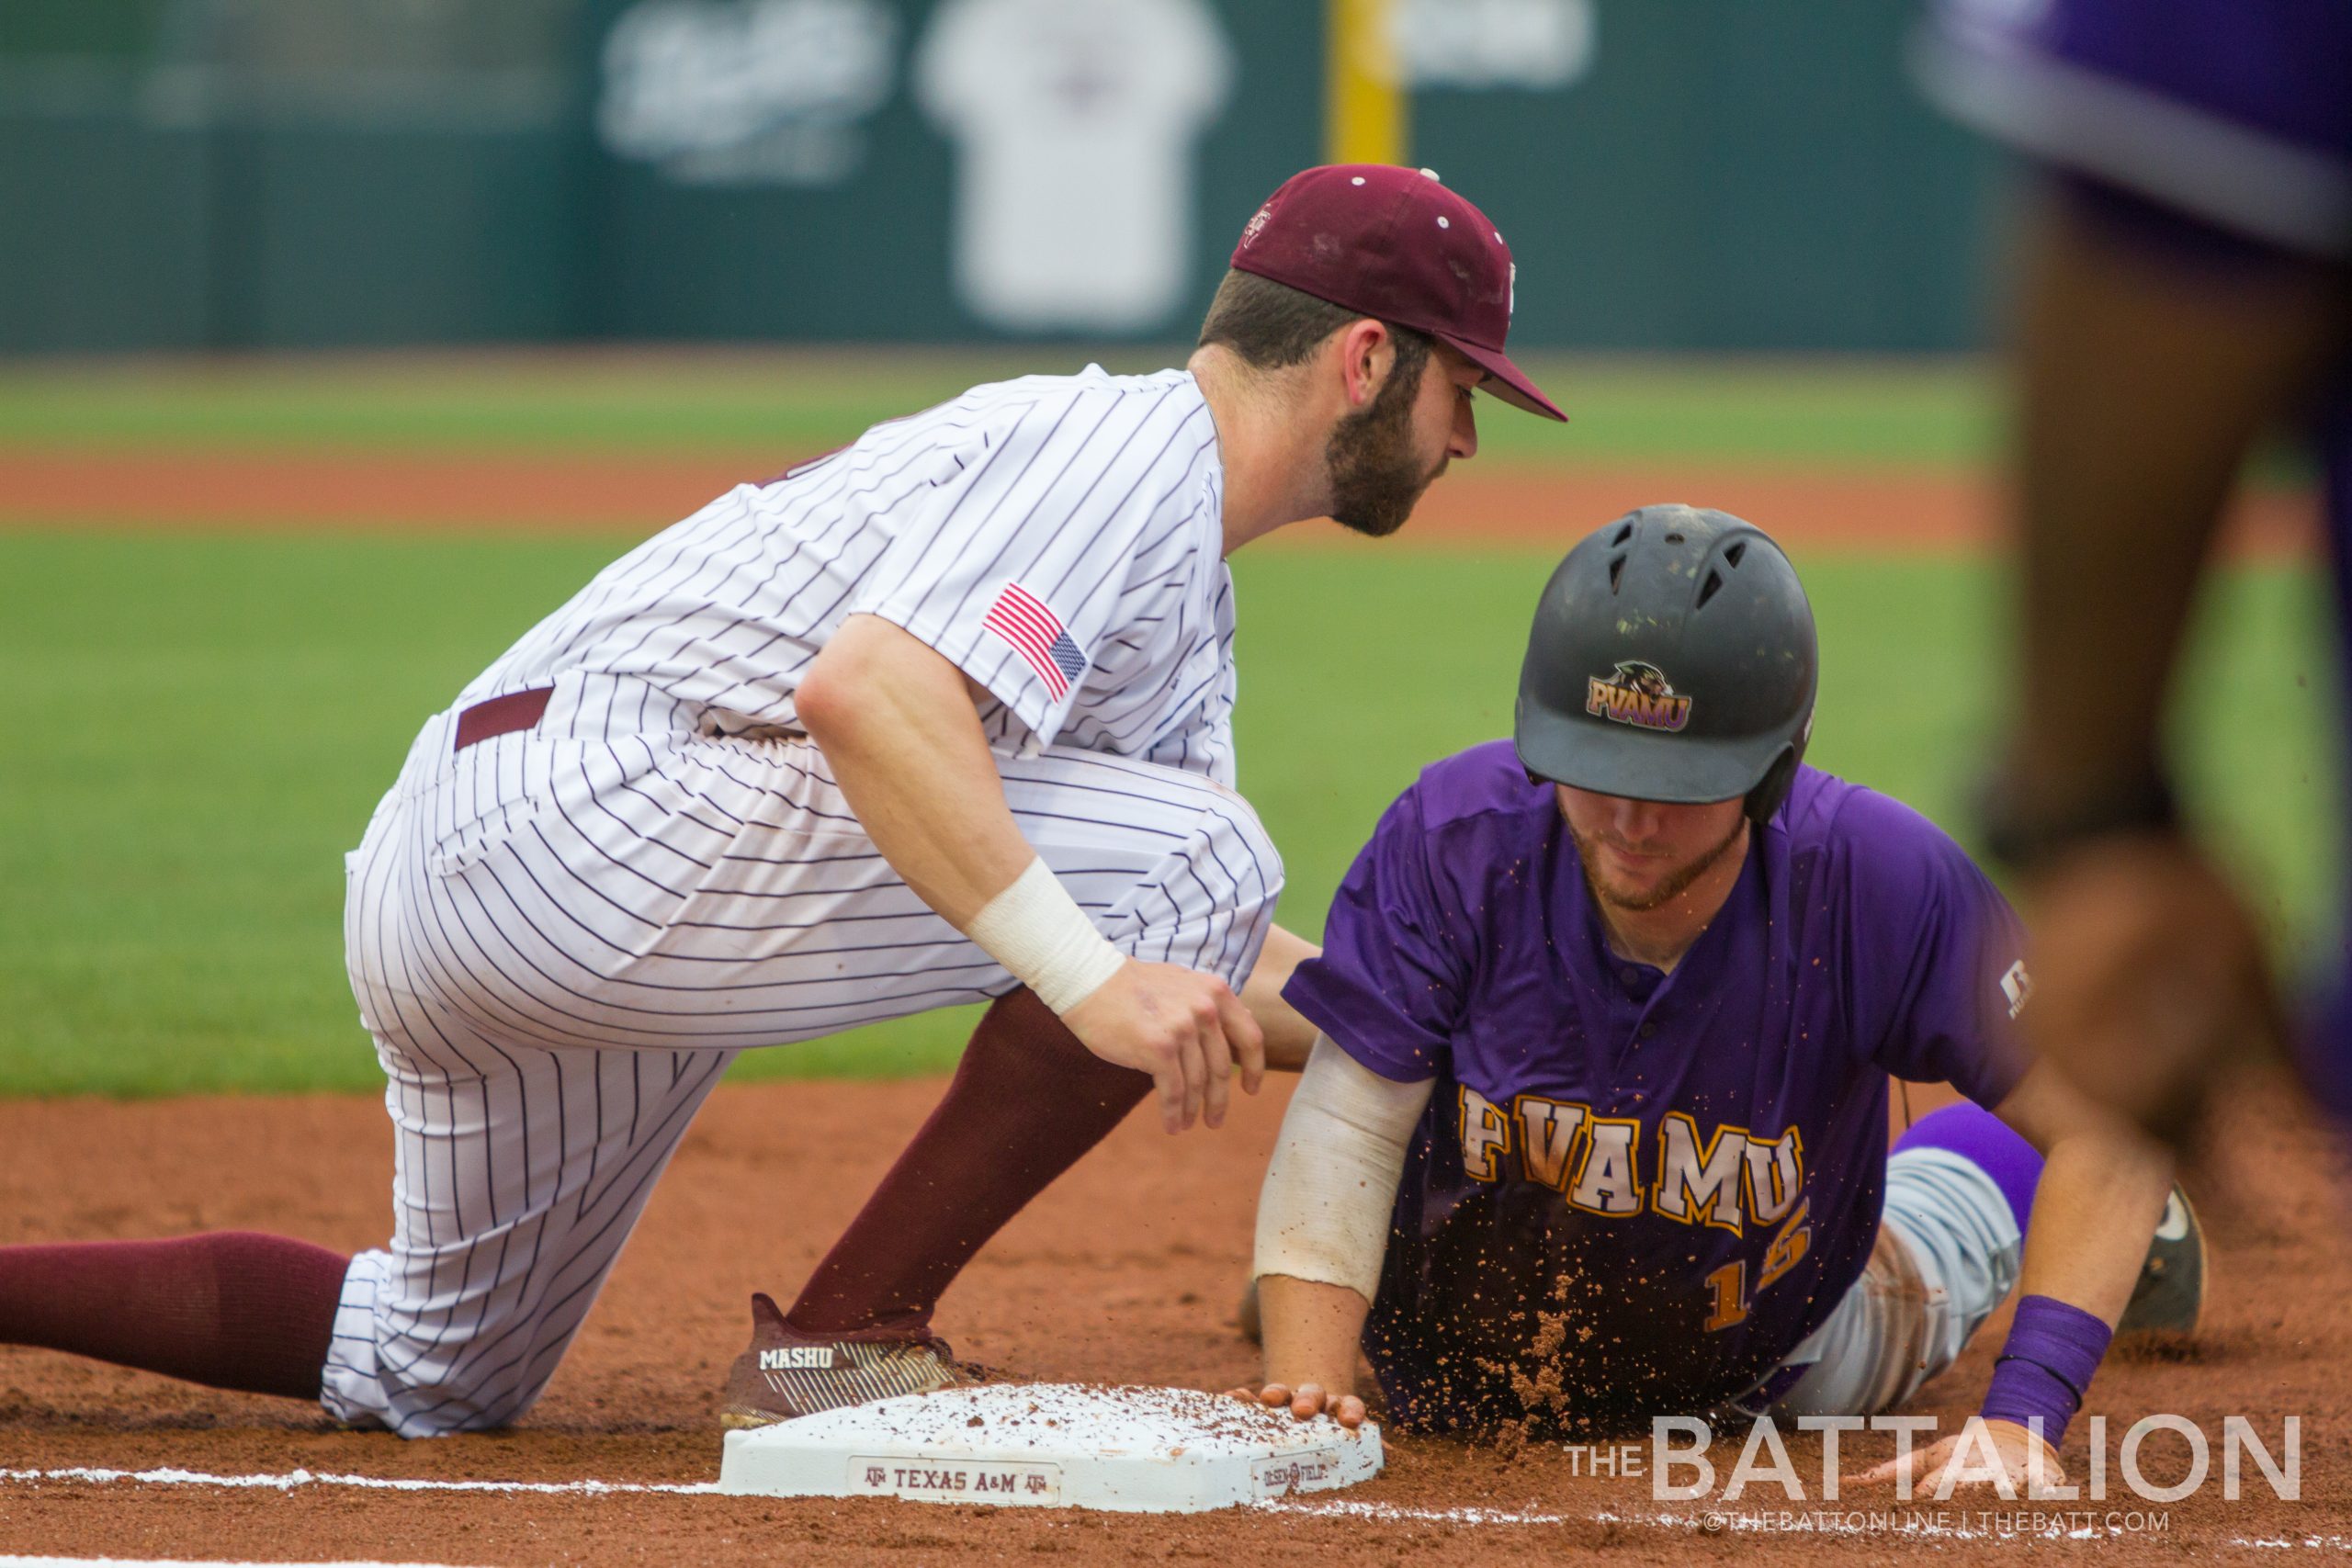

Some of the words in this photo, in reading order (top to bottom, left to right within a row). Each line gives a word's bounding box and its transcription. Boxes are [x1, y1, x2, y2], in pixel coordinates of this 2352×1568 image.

[1587, 677, 1691, 732] PVAMU
[1459, 1084, 1804, 1239] PVAMU
[760, 1347, 833, 1370] MASHU
[894, 1470, 967, 1490] TEXAS
[974, 1472, 1016, 1493] A&M
